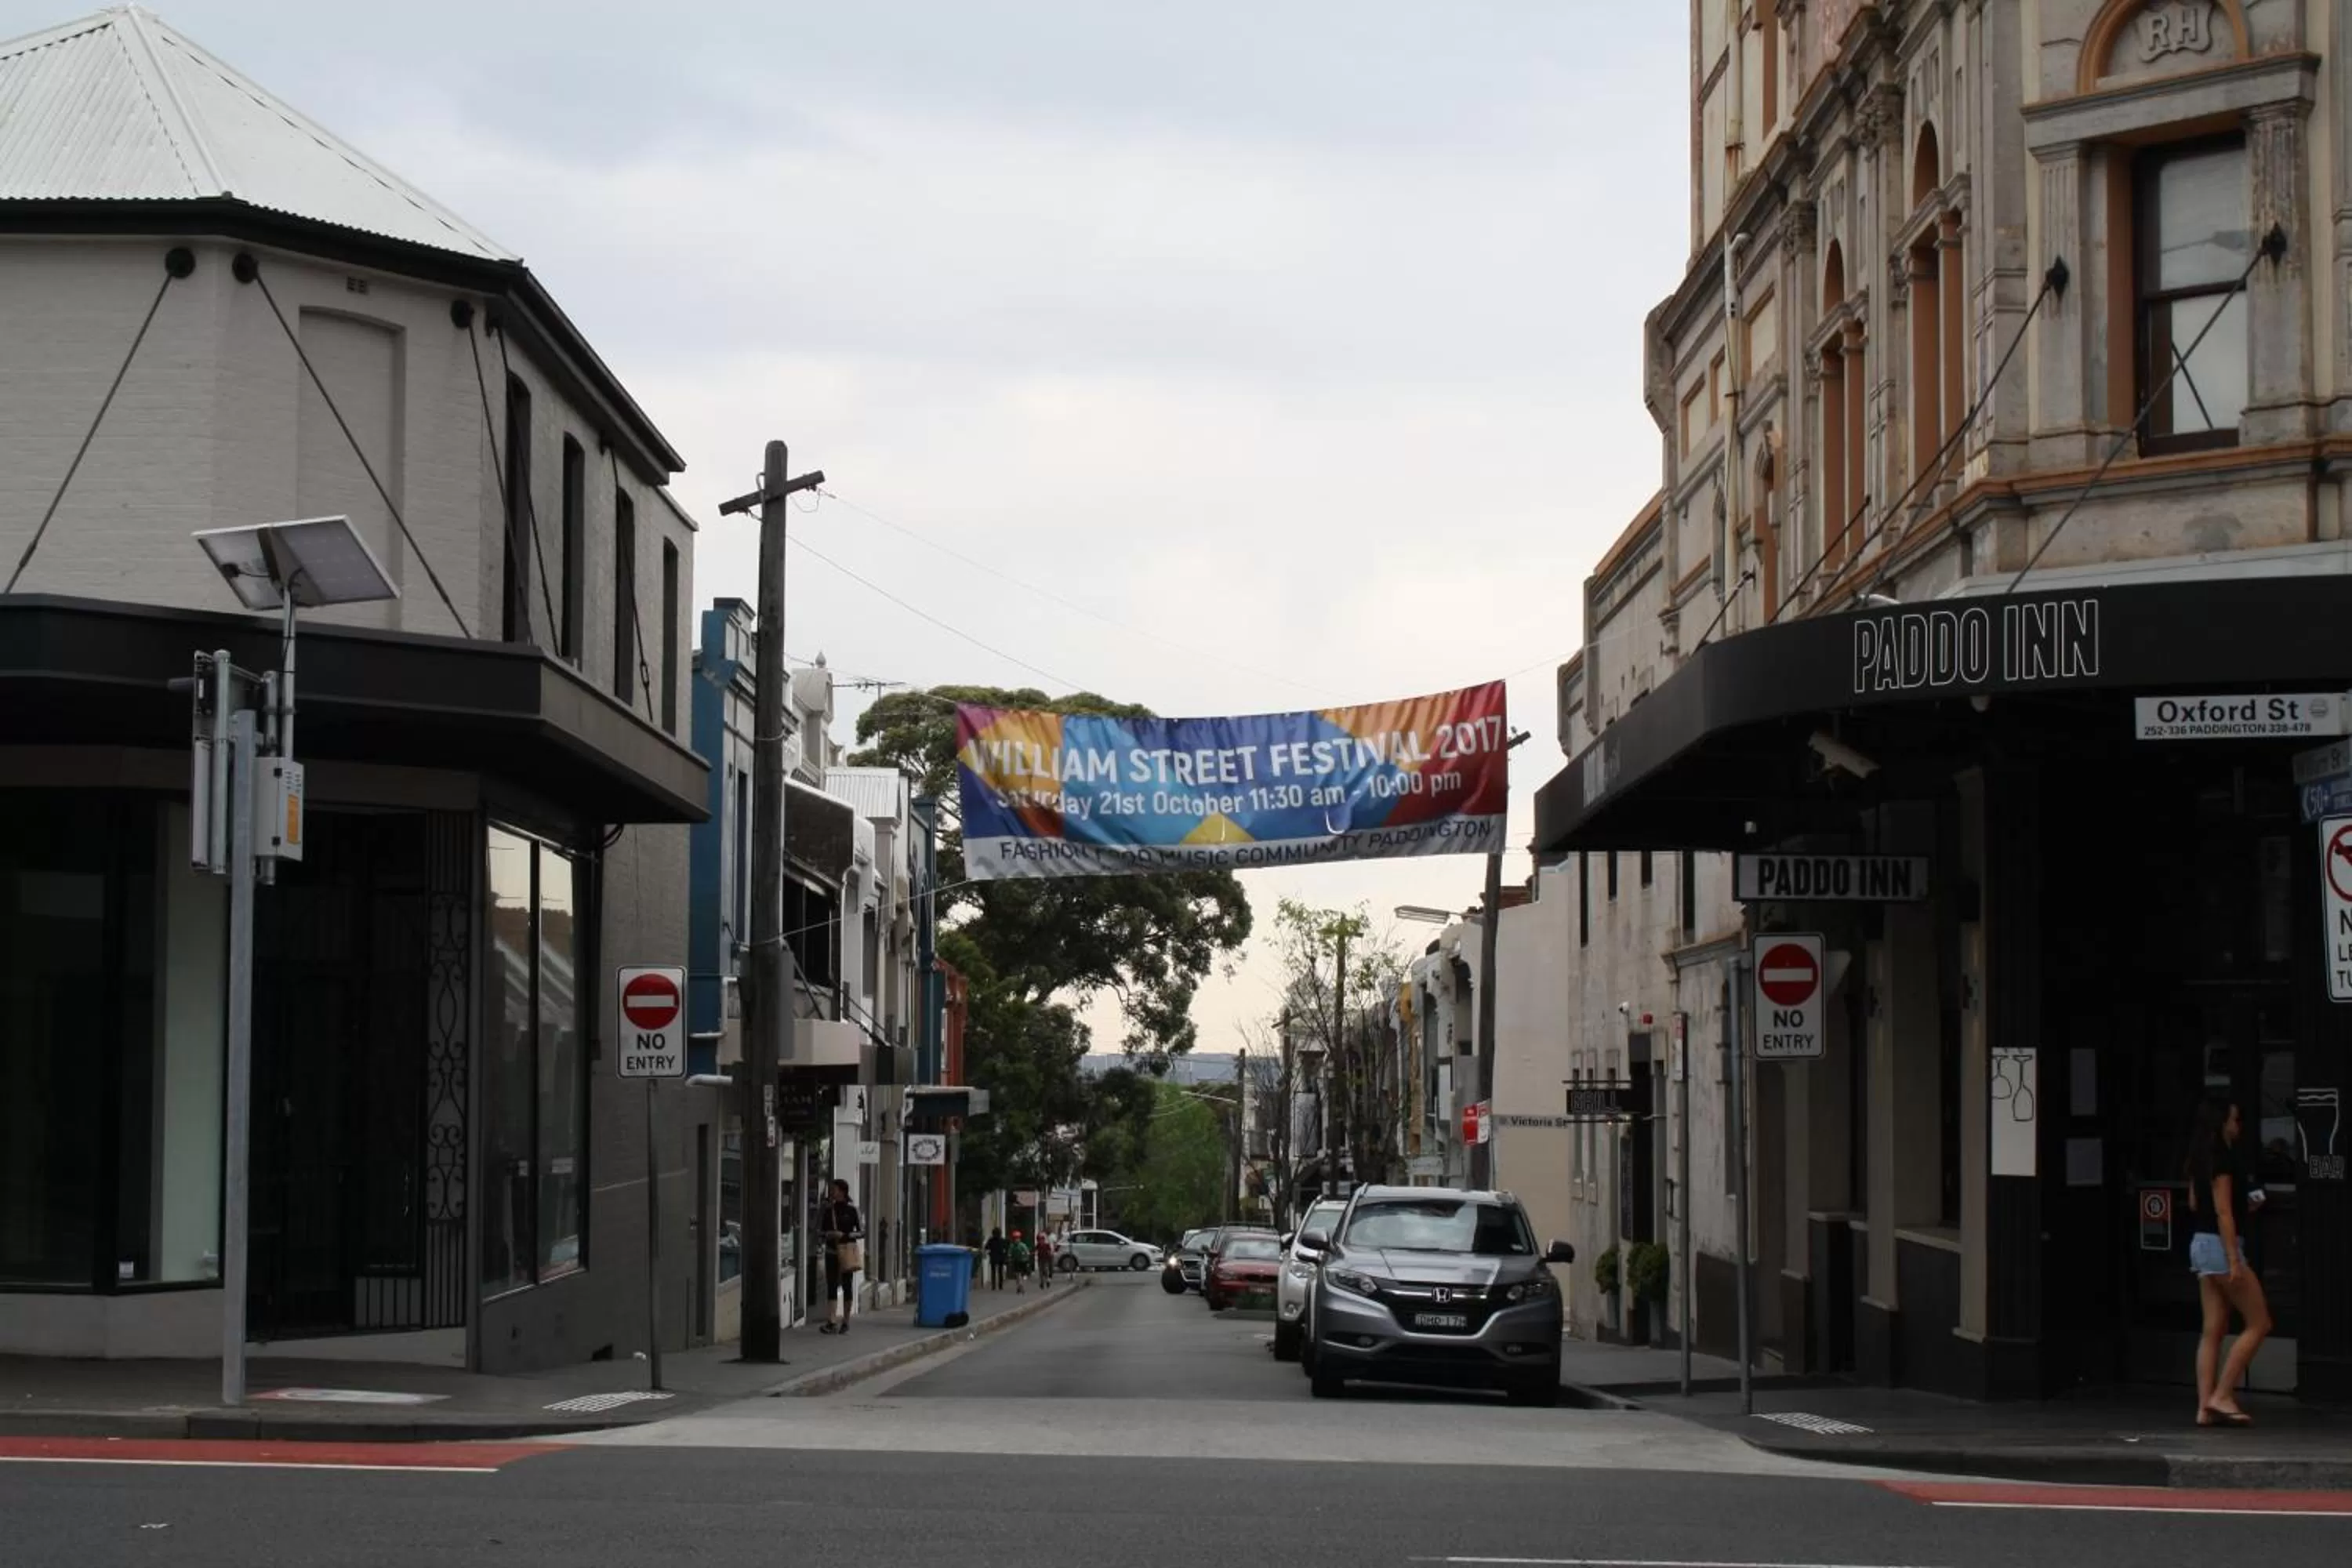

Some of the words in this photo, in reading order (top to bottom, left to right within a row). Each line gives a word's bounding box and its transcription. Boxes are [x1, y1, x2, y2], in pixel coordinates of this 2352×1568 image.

[1854, 607, 1990, 694] PADDO
[2004, 599, 2099, 681] INN
[2156, 699, 2257, 723] Oxford
[2267, 697, 2300, 721] St
[2190, 723, 2267, 735] PADDINGTON
[967, 739, 1117, 784] WILLIAM
[1129, 746, 1258, 786] STREET
[1270, 730, 1431, 778] FESTIVAL
[1436, 715, 1502, 759] 2017
[997, 786, 1092, 821] Saturday
[1099, 790, 1145, 815] 21st
[1152, 790, 1243, 817] October
[1249, 784, 1302, 811] 11:30
[1309, 786, 1346, 807] am
[1367, 771, 1424, 799] 10:00
[1431, 771, 1462, 797] pm
[1001, 841, 1089, 861] FASHION
[1367, 819, 1493, 848] PADDINGTON
[1758, 858, 1850, 896] PADDO
[1860, 858, 1912, 897] INN
[1773, 1008, 1805, 1029] NO
[637, 1033, 666, 1051] NO
[1763, 1034, 1815, 1050] ENTRY
[626, 1054, 675, 1070] ENTRY
[1511, 1115, 1552, 1127] Victoria
[2309, 1154, 2345, 1179] BAR
